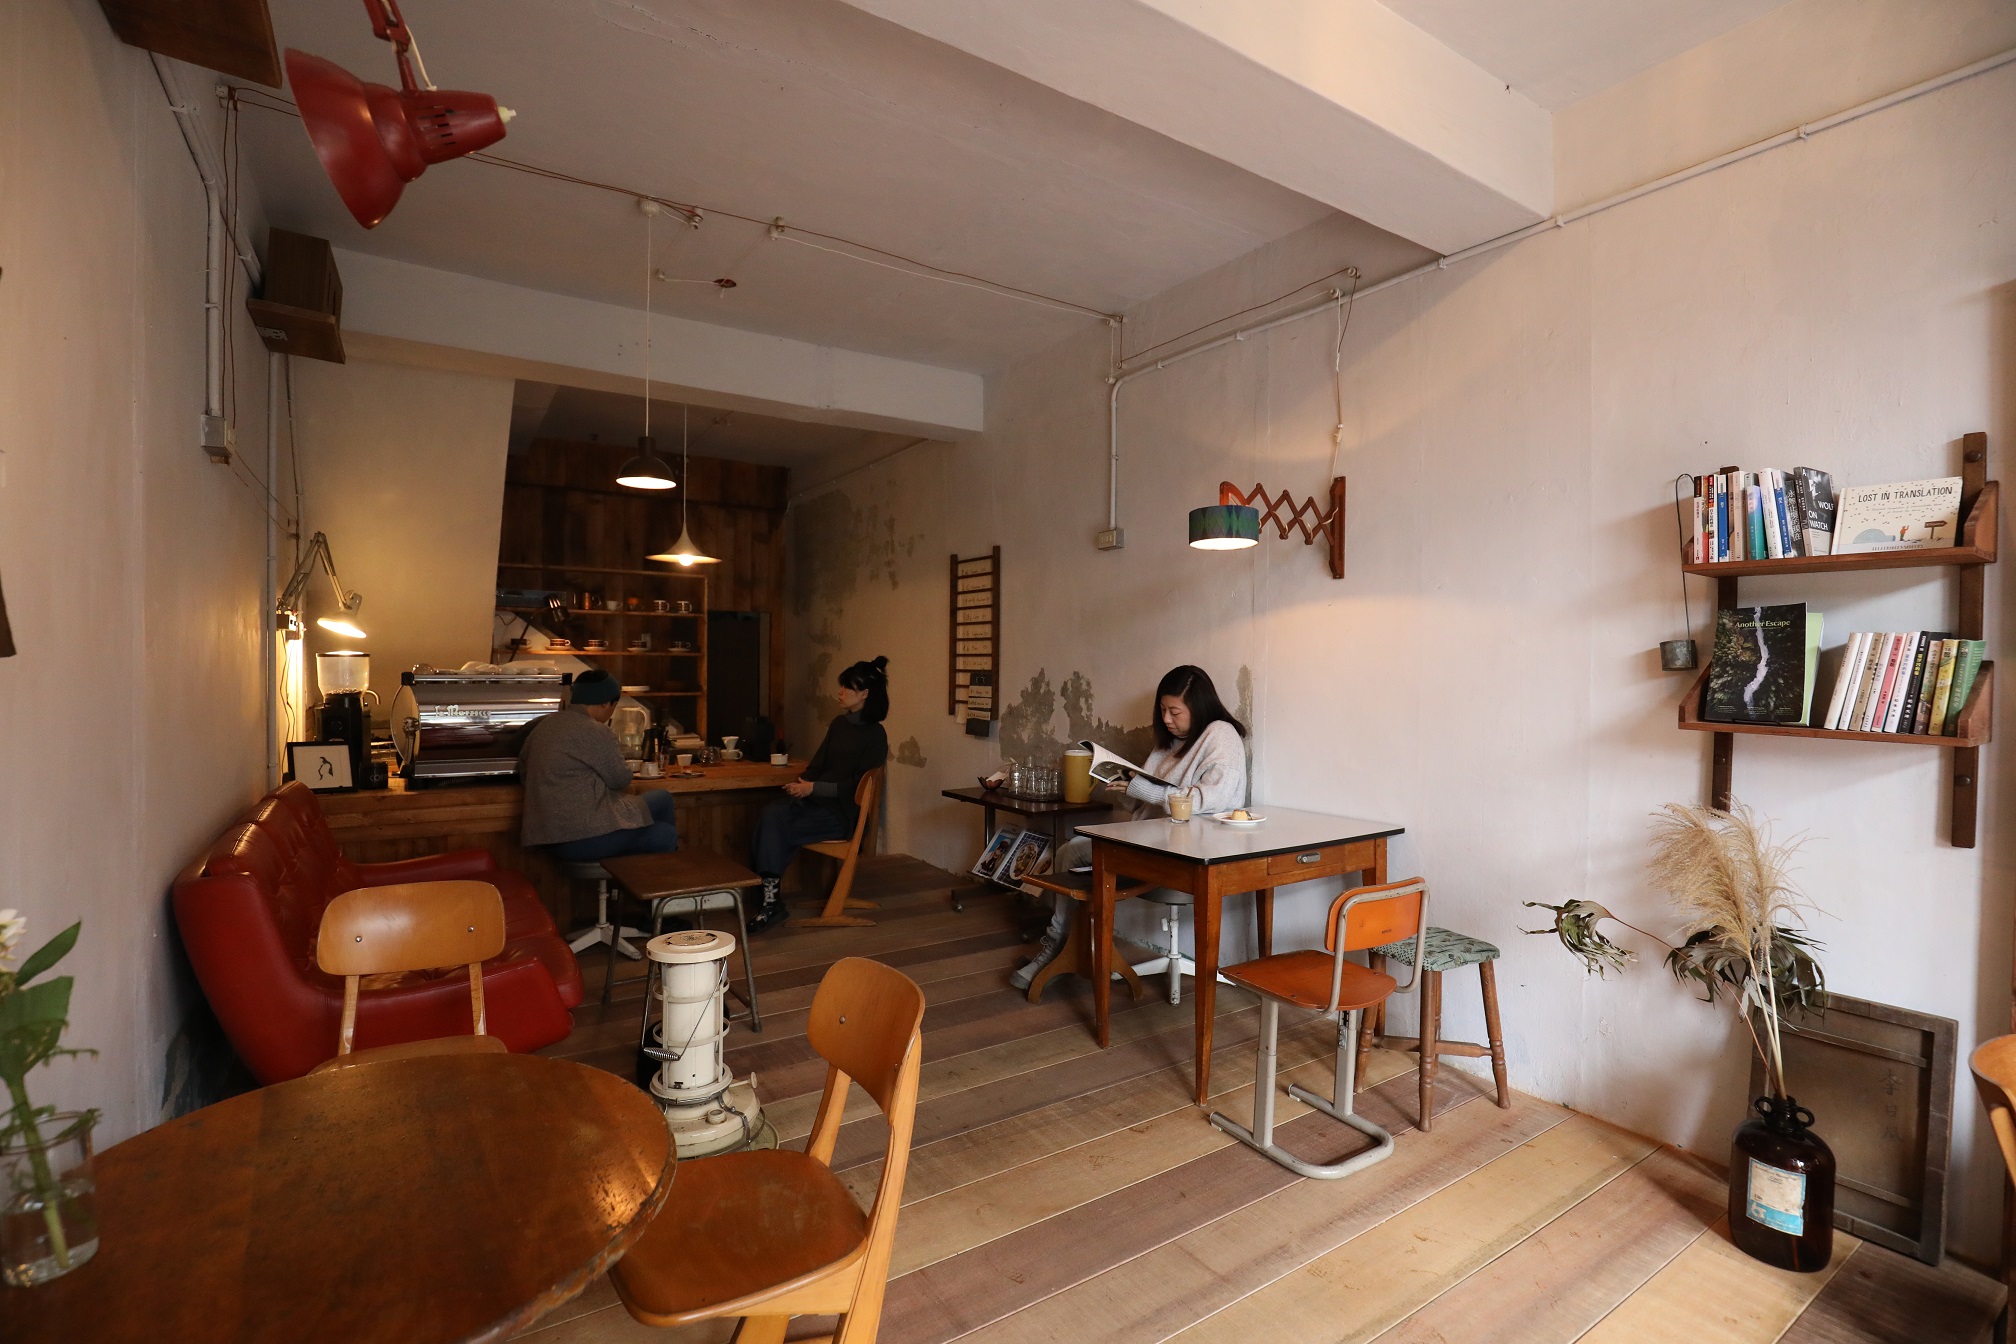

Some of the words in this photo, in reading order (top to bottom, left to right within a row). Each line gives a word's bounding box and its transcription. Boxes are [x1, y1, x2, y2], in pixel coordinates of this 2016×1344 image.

[1858, 494, 1878, 503] LOST
[1881, 492, 1891, 500] IN
[1894, 486, 1953, 499] TRANSLATION
[1817, 500, 1834, 511] WOLF
[1808, 510, 1818, 519] ON
[1808, 519, 1828, 531] WATCH
[1735, 620, 1765, 628] Another
